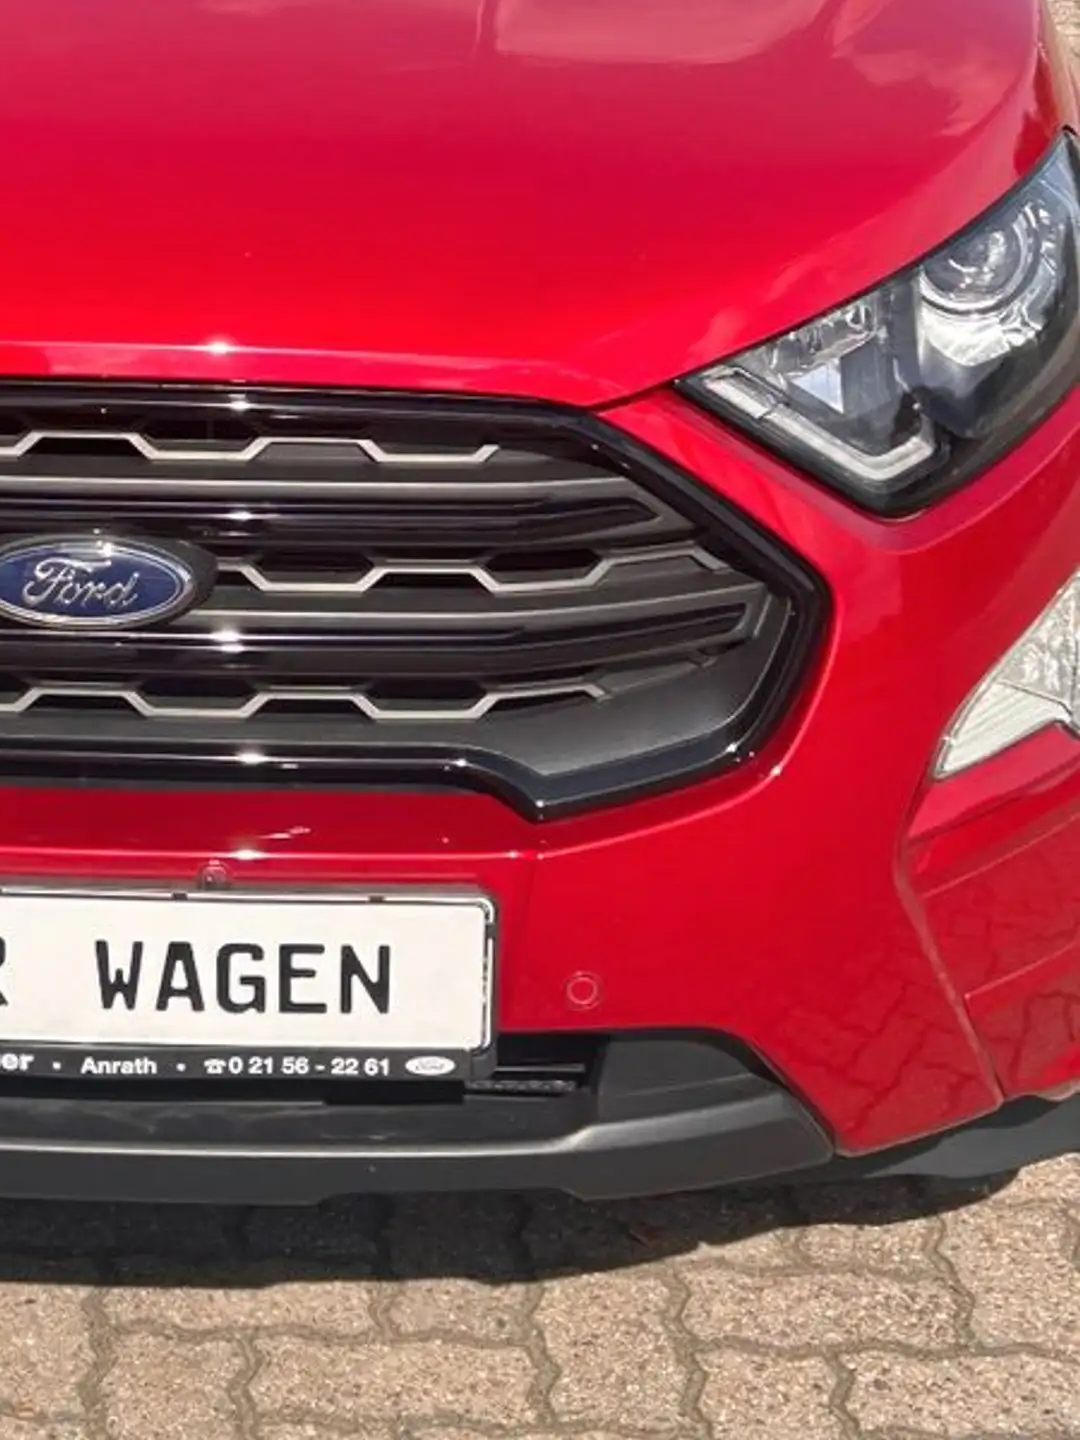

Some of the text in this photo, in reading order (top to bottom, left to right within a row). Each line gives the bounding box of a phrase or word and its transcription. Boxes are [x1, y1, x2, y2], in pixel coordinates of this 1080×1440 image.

[22, 557, 141, 606] Ford
[95, 940, 390, 1014] WAGEN
[80, 1056, 158, 1075] Anrath
[247, 1056, 274, 1075] 21
[280, 1056, 310, 1075] 56
[330, 1057, 360, 1076] 22
[363, 1058, 390, 1077] 61
